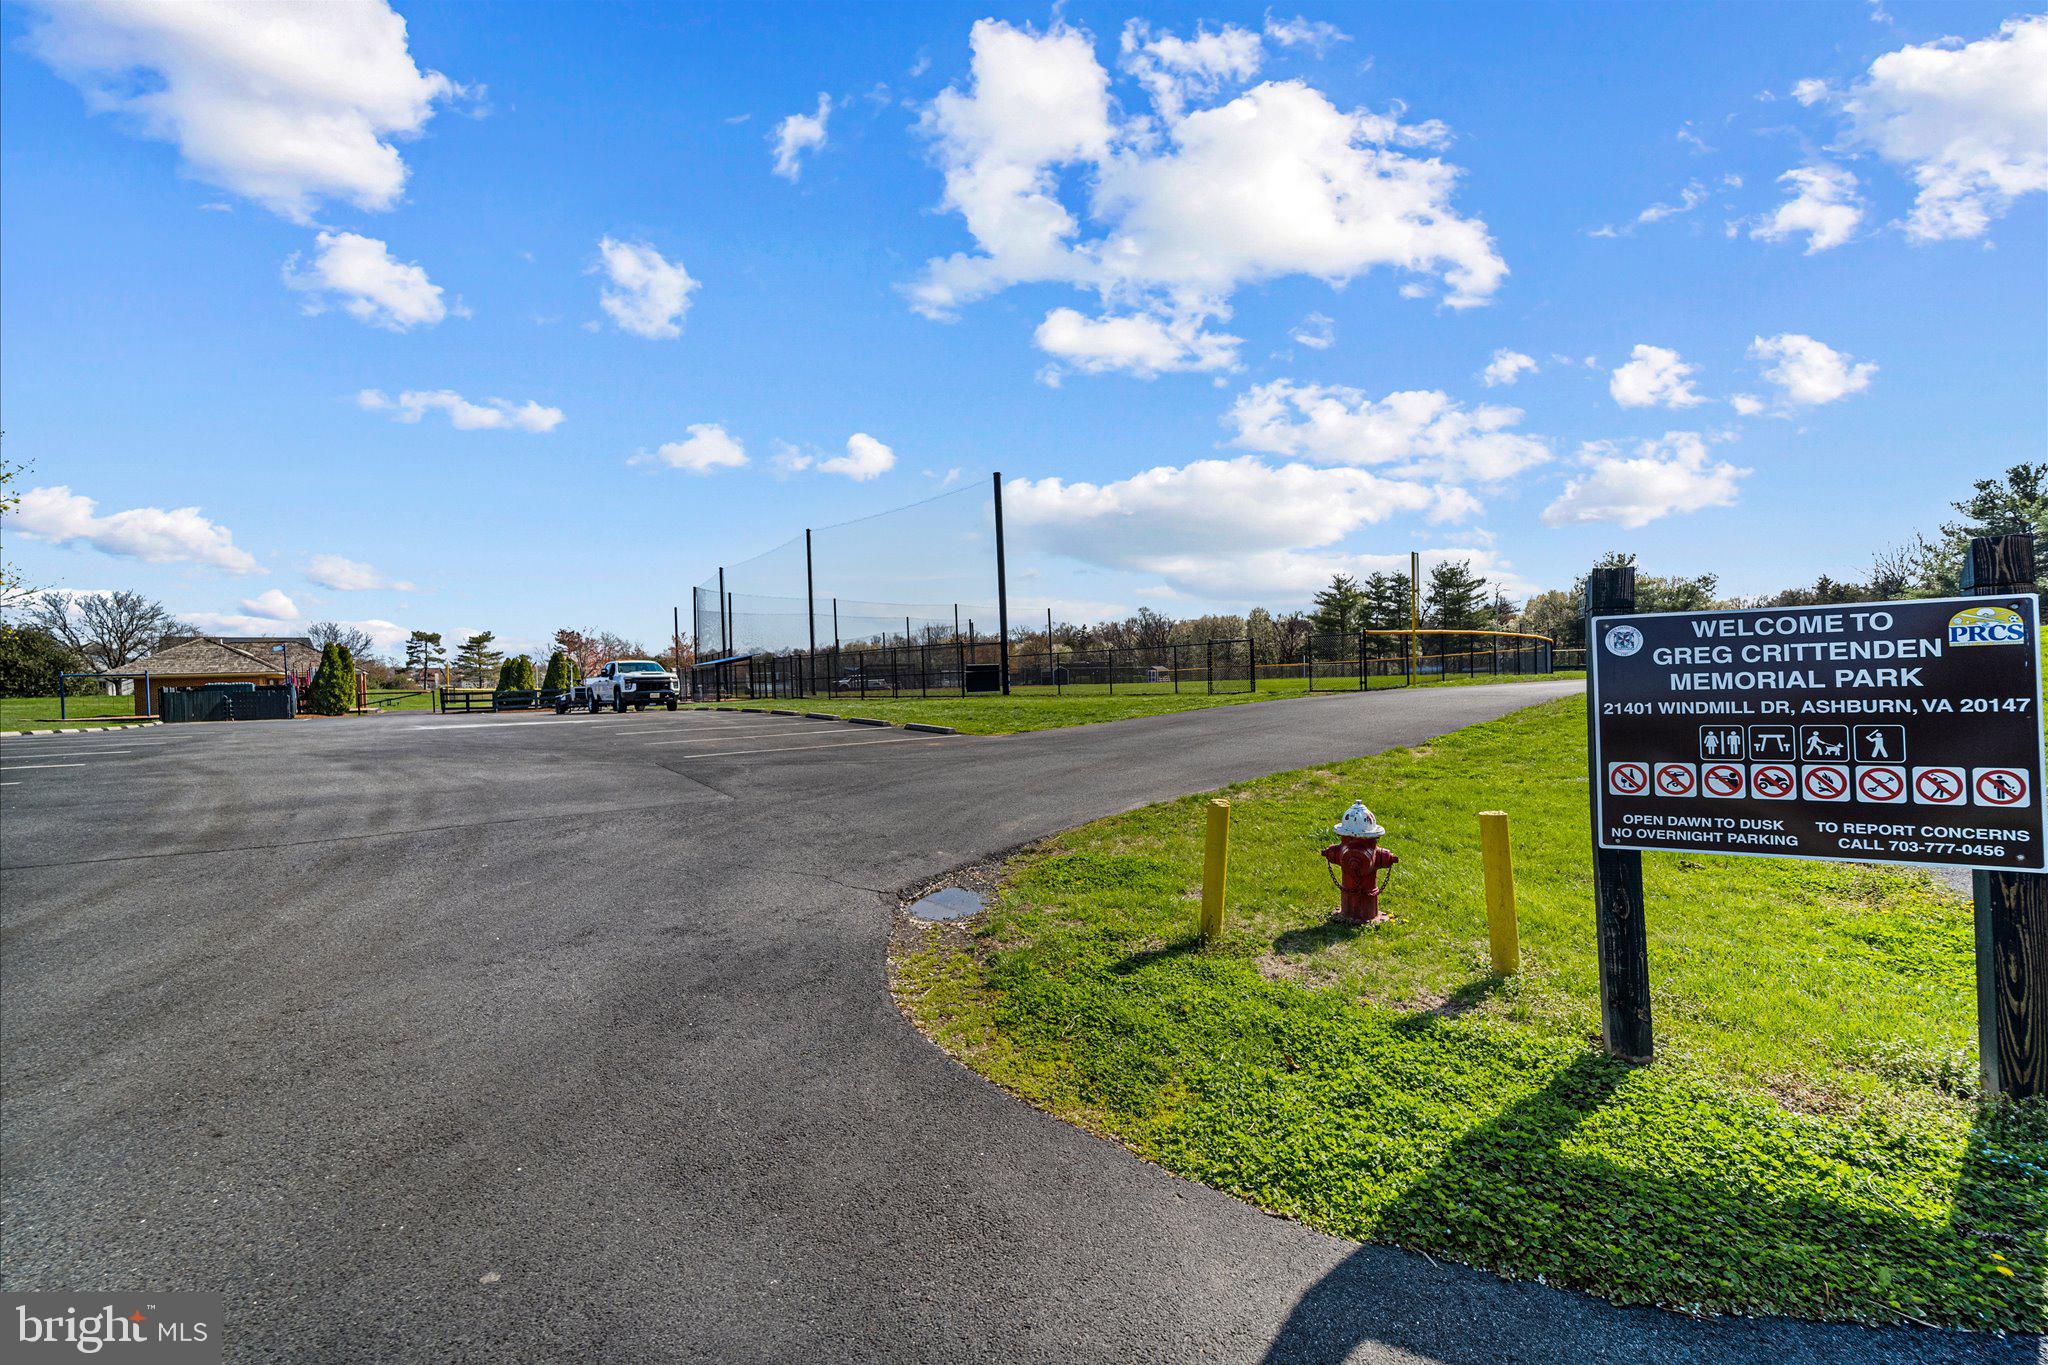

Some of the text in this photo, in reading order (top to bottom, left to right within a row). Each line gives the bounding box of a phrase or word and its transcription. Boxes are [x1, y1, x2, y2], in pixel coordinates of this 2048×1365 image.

[1692, 611, 1893, 638] WELCOME TO
[1949, 623, 2025, 642] PRCS
[1653, 638, 1942, 666] GREG CRITTENDEN
[1670, 667, 1924, 691] MEMORIAL PARK
[1603, 698, 2031, 717] 21401 WINDMILL DR, ASHBURN, VA 20147
[1622, 814, 1785, 832] OPEN DAWN TO DUSK
[1815, 821, 2031, 843] TO REPORT CONCERNS
[1611, 827, 1798, 847] NO OVERNIGHT PARKING
[1838, 838, 2006, 858] CALL 703-777-0456
